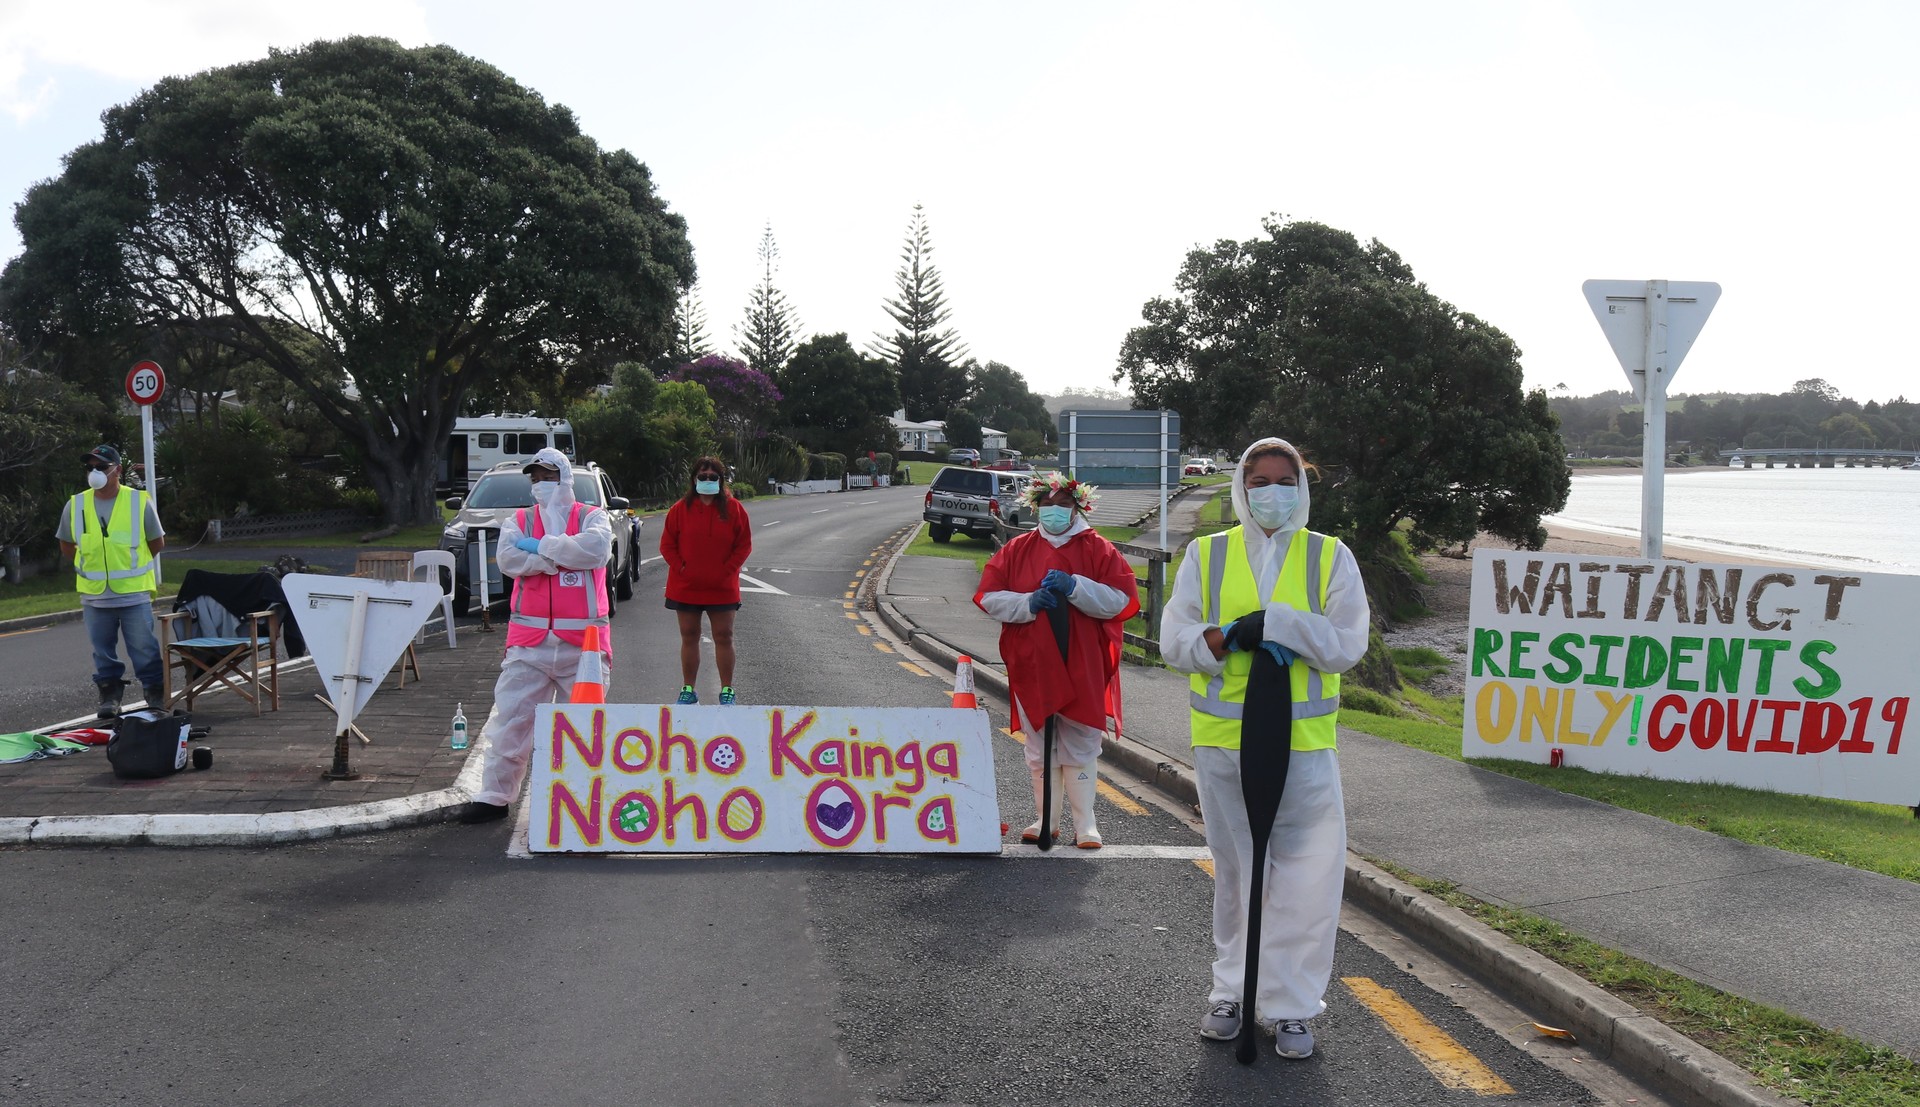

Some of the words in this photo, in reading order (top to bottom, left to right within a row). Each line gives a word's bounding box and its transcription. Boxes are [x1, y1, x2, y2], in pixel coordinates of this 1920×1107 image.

[135, 375, 156, 391] 50
[940, 499, 979, 512] TOYOTA
[1471, 627, 1842, 699] RESIDENTS
[551, 706, 744, 776] Noho
[768, 707, 960, 795] Kainga
[546, 776, 764, 848] Noho
[804, 777, 959, 848] Ora
